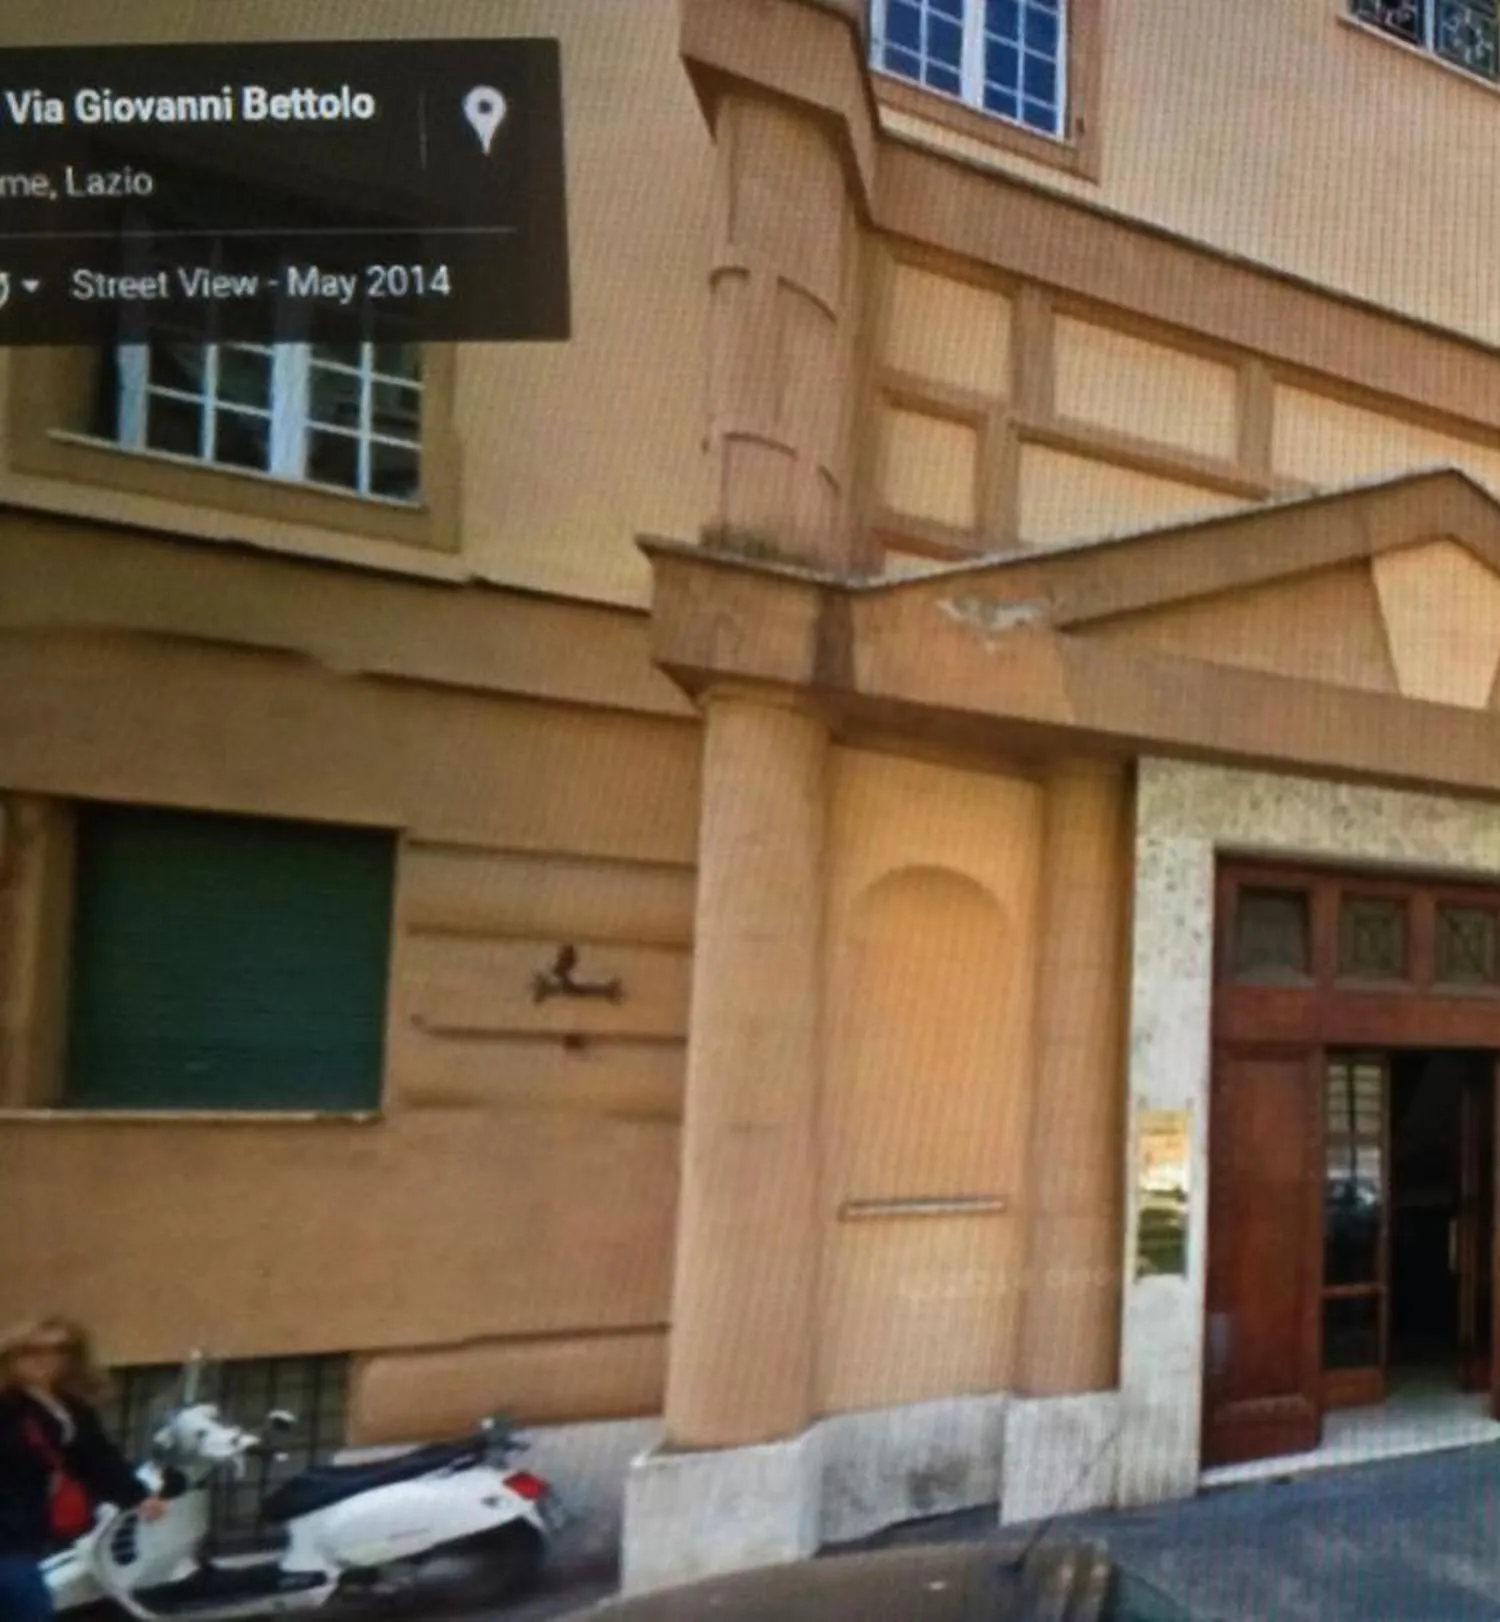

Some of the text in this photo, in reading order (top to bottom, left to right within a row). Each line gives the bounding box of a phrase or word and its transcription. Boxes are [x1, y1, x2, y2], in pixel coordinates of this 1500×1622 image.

[5, 85, 376, 124] Via Giovanni Bettolo
[66, 166, 153, 197] Lazio
[72, 267, 169, 300] Street
[179, 267, 258, 298] View
[287, 266, 357, 304] May
[367, 264, 451, 297] 2014
